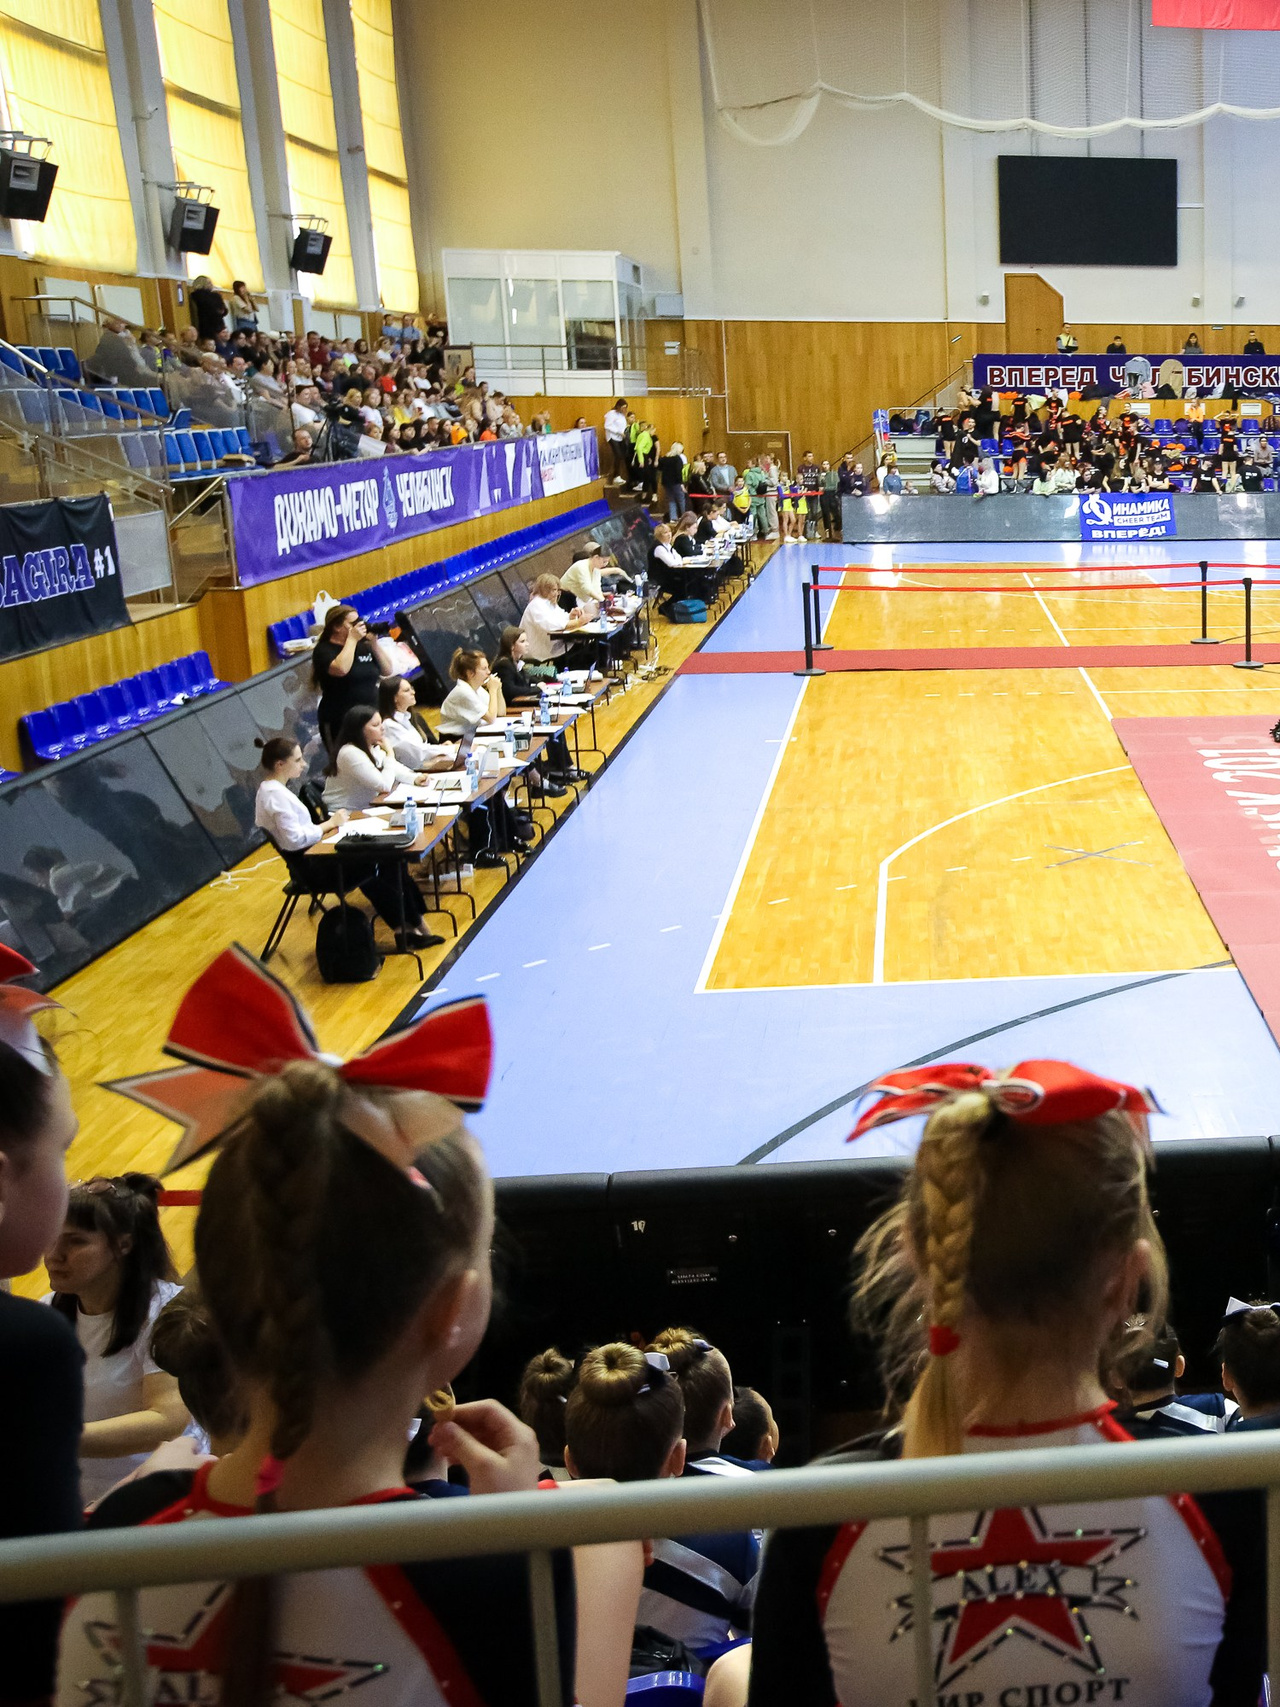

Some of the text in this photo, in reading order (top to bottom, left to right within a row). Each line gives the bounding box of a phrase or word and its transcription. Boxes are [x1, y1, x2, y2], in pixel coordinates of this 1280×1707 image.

[987, 366, 1099, 391] ВПЕРЕД
[274, 466, 455, 556] ДИНАМО-МЕТАР ЧЕЛЯБИНСК
[1116, 513, 1169, 525] CHEER TEAM
[1091, 526, 1167, 539] ВПЕРЁД!
[0, 543, 116, 608] AGIRA #1
[963, 1563, 1068, 1599] ALEX
[910, 1677, 1130, 1707] ИР СПОРТ
